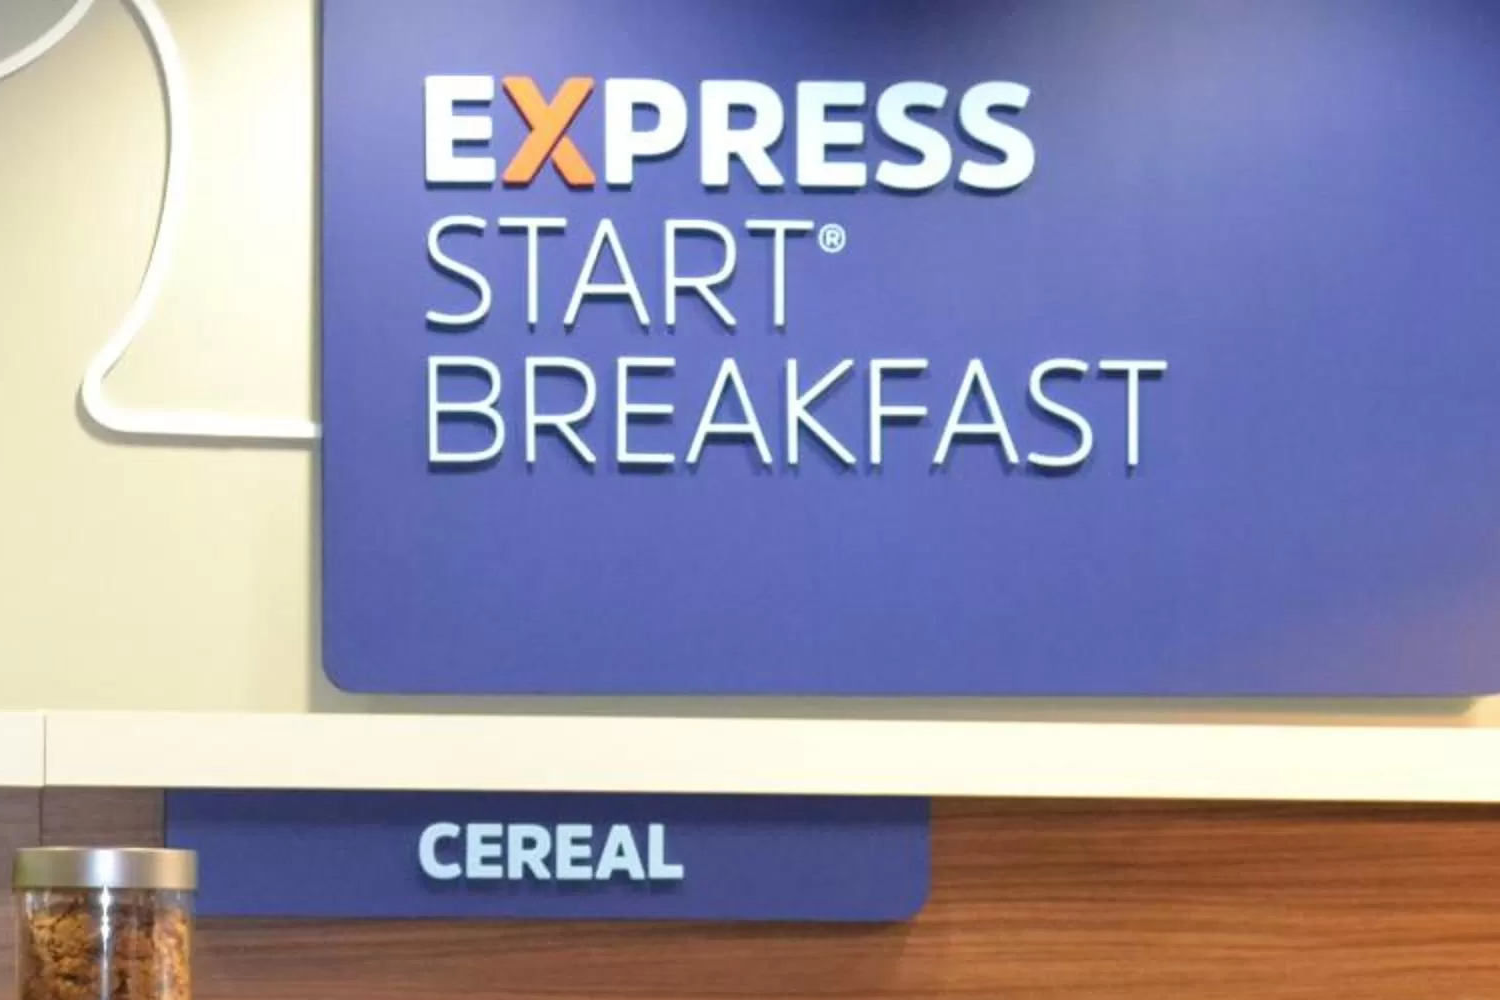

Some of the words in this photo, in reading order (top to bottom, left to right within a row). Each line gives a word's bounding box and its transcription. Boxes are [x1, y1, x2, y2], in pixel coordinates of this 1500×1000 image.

[424, 74, 1036, 190] EXPRESS
[427, 355, 1168, 467] BREAKFAST
[418, 821, 685, 880] CEREAL
